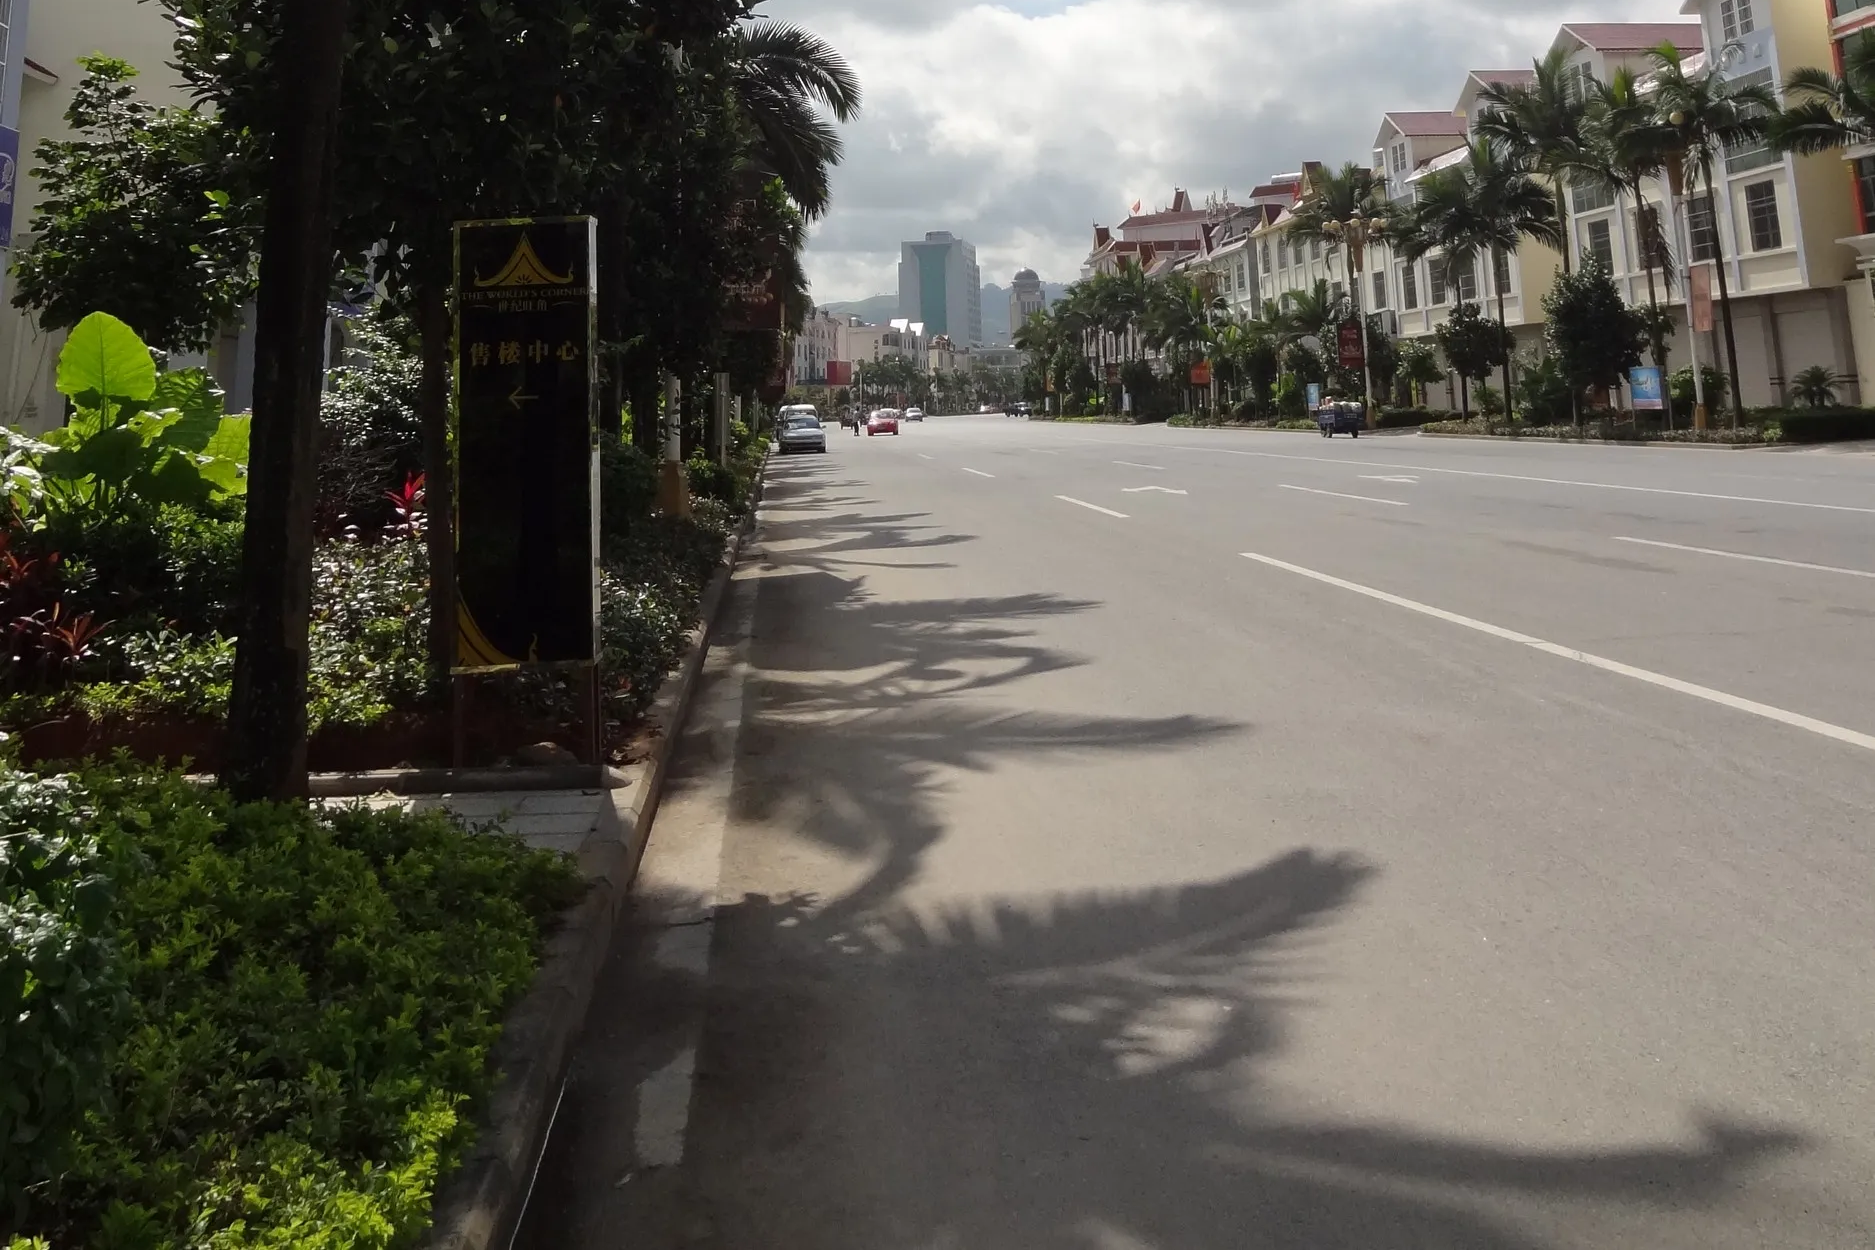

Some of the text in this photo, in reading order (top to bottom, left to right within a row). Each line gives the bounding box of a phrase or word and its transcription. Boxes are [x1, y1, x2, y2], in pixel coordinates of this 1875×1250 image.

[461, 287, 588, 301] THE WORLD'S CORNER
[469, 339, 580, 367] 售楼中心
